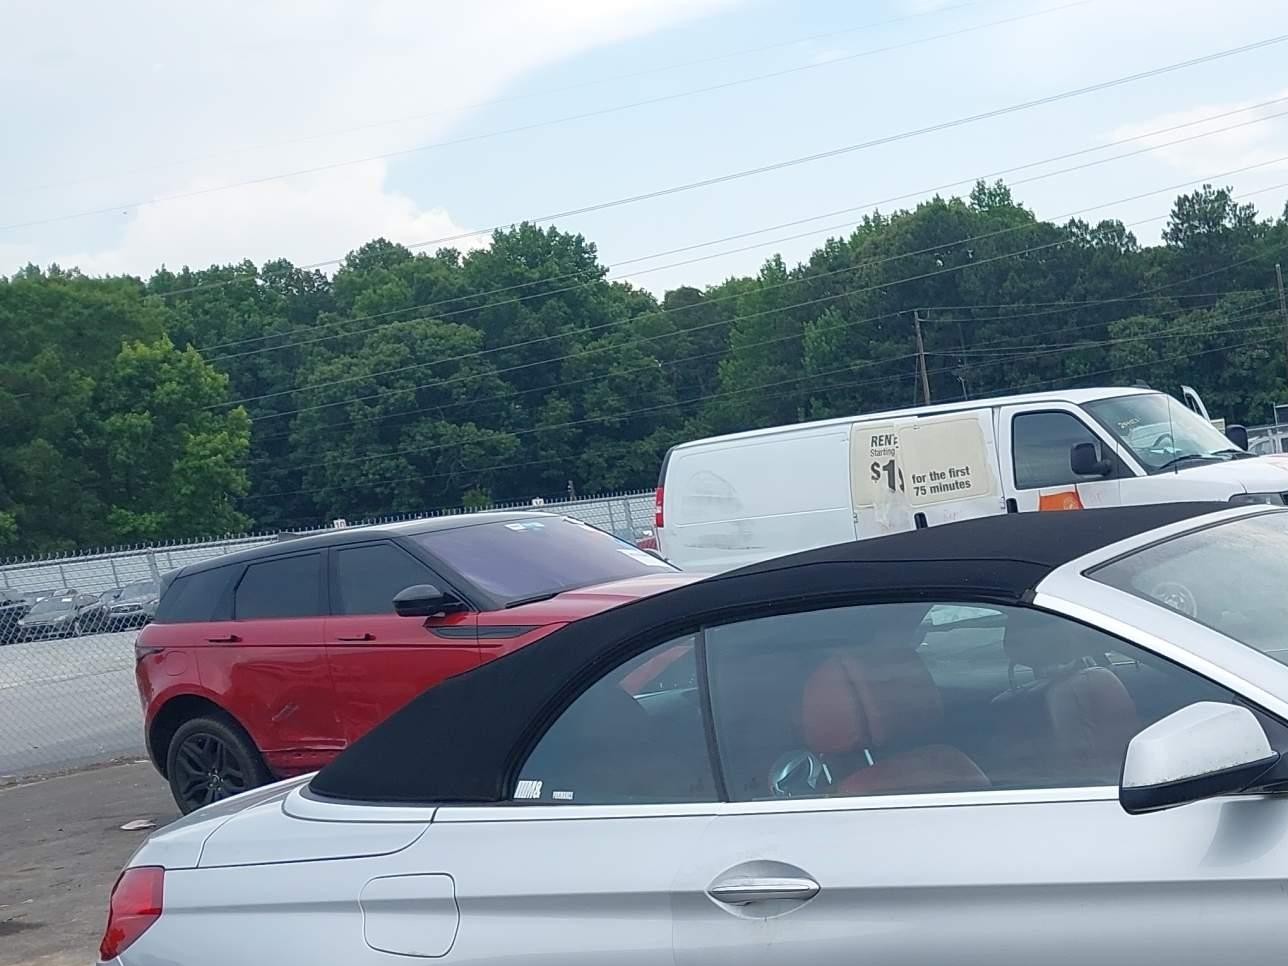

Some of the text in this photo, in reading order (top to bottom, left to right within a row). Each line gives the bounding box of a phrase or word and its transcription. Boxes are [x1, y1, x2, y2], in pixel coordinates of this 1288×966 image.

[911, 466, 970, 484] for the first
[913, 480, 971, 496] 75 minutes
